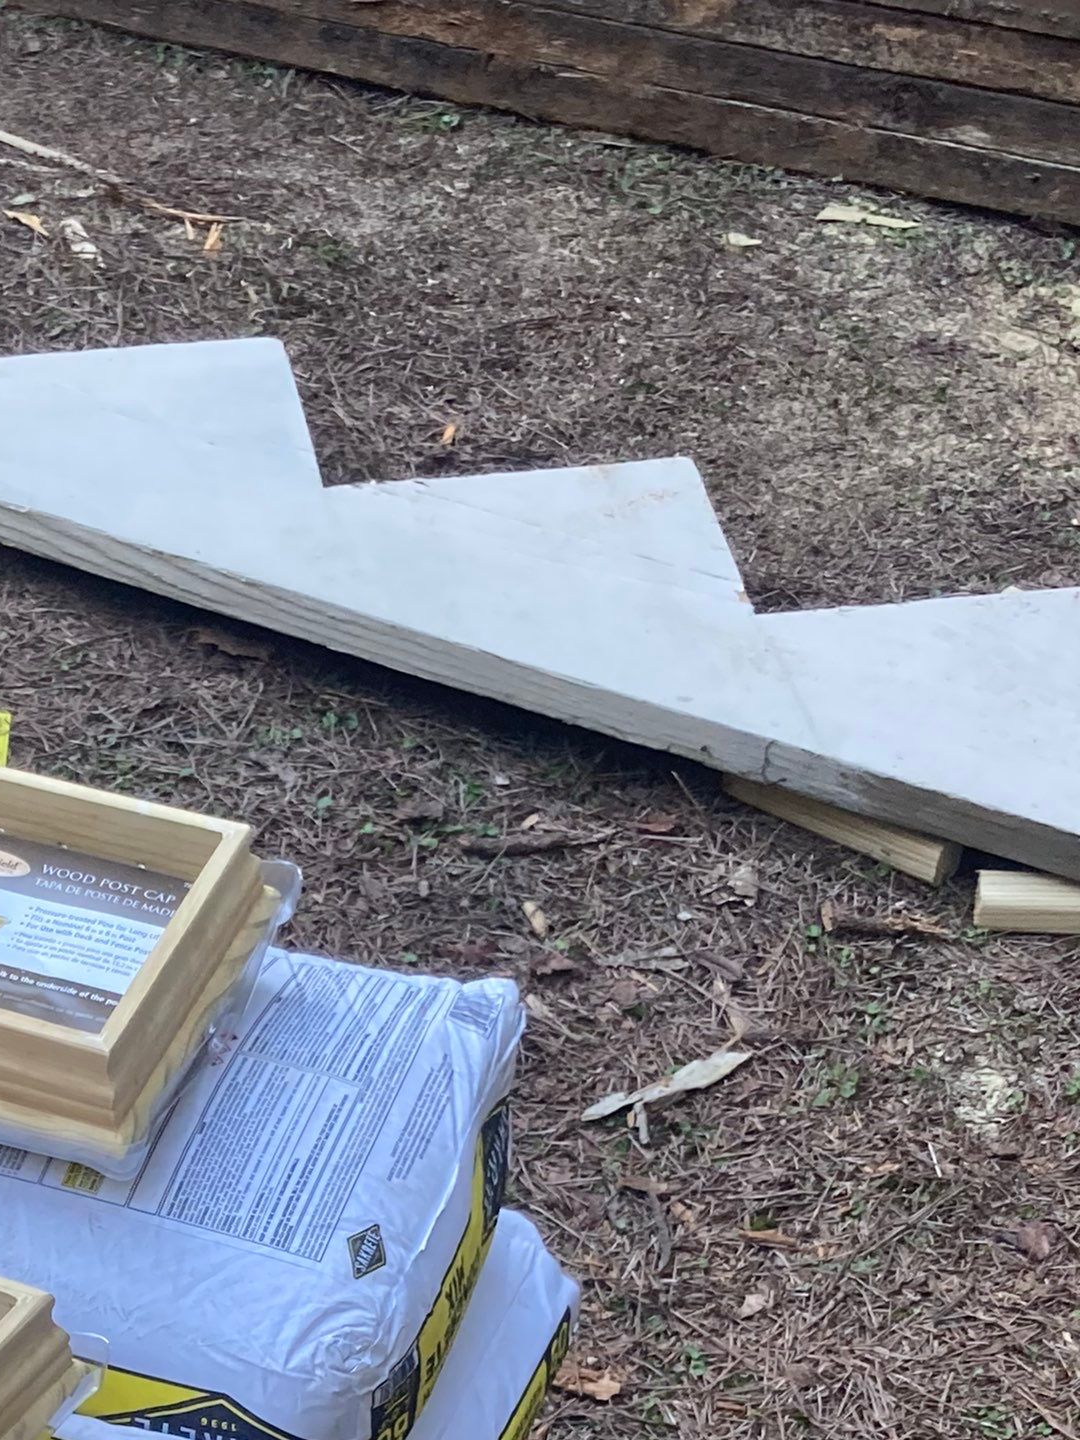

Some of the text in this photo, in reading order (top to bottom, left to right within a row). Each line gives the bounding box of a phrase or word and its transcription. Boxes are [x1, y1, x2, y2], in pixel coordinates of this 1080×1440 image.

[35, 878, 63, 892] TAPA
[65, 884, 82, 897] DE
[84, 889, 120, 907] POSTE
[122, 898, 141, 910] DE
[42, 863, 95, 885] WOOD
[100, 877, 140, 897] POST
[144, 888, 177, 904] CAP
[9, 973, 19, 981] to
[20, 975, 34, 985] the
[36, 980, 78, 997] underside
[78, 990, 90, 998] of
[90, 993, 105, 1002] the
[356, 1230, 382, 1274] SAKRETE
